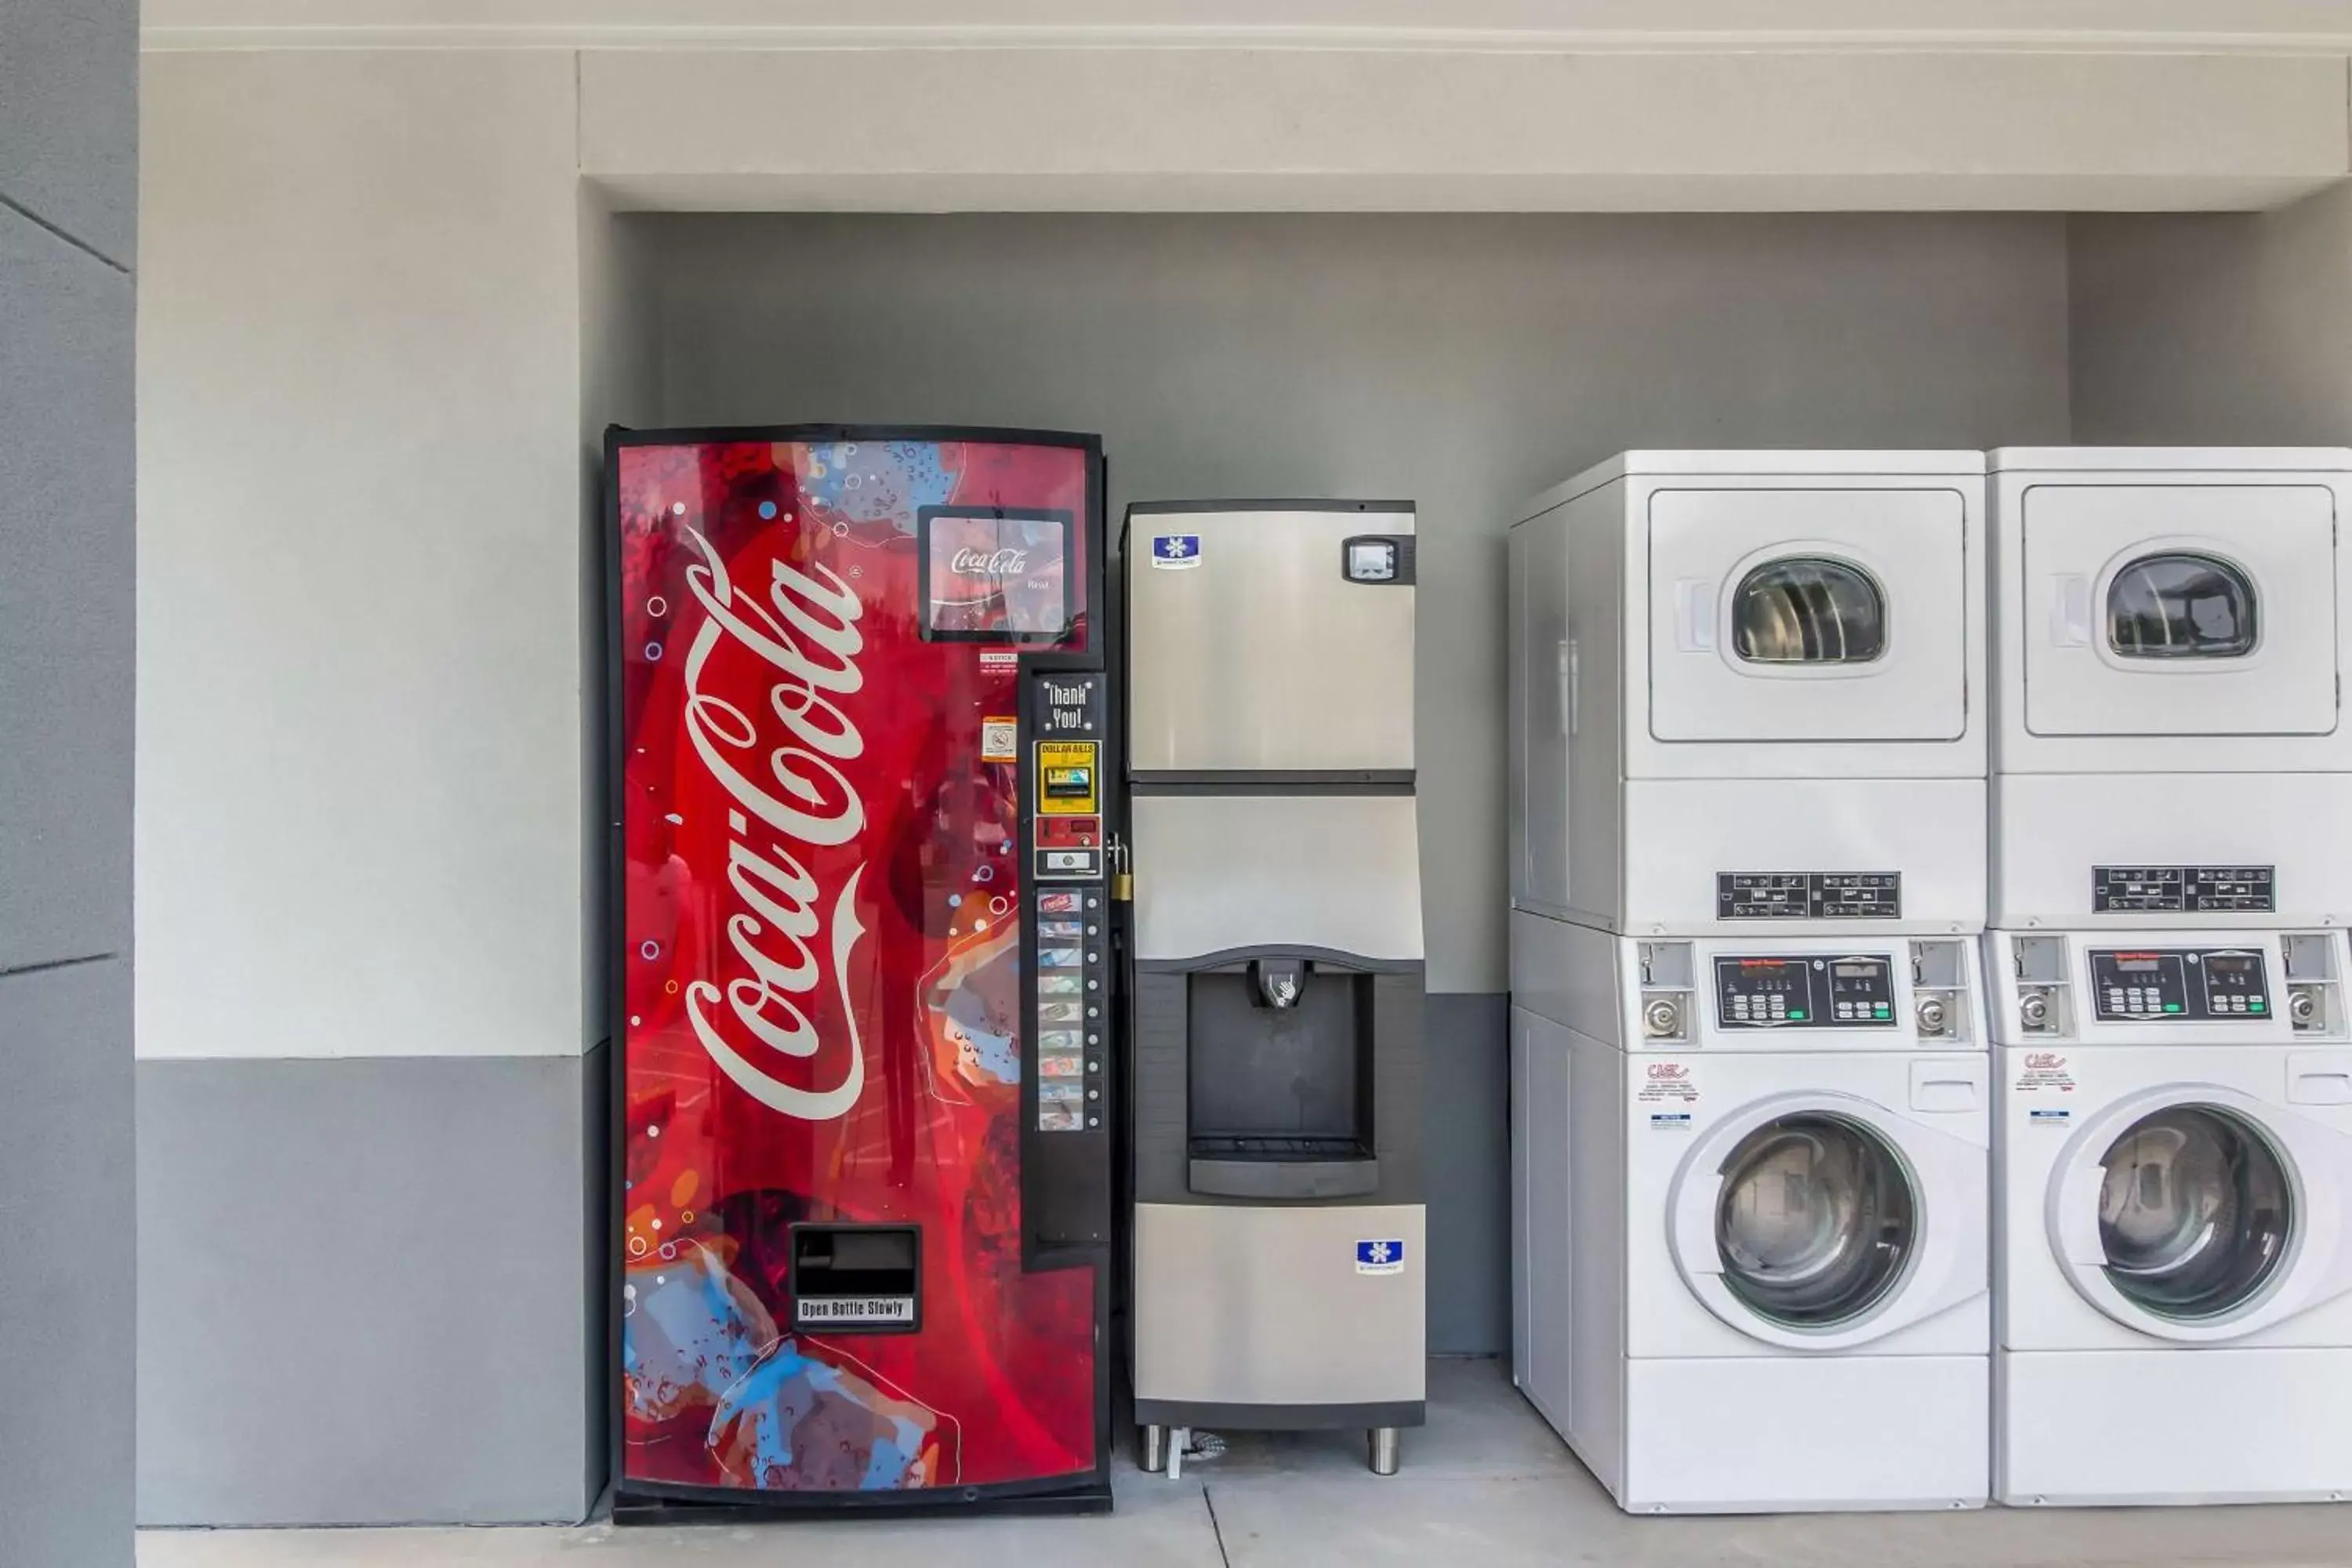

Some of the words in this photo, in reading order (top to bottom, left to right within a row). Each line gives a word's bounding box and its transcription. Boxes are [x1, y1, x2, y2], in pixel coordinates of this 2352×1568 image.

[1049, 684, 1087, 706] Thank
[1053, 708, 1082, 728] You!
[1042, 744, 1072, 753] DOLLAR
[1073, 744, 1094, 753] BILLS
[685, 524, 866, 1121] Coca-Cola
[802, 1302, 829, 1317] Open
[832, 1301, 865, 1316] Bottle
[868, 1301, 903, 1317] Slowly
